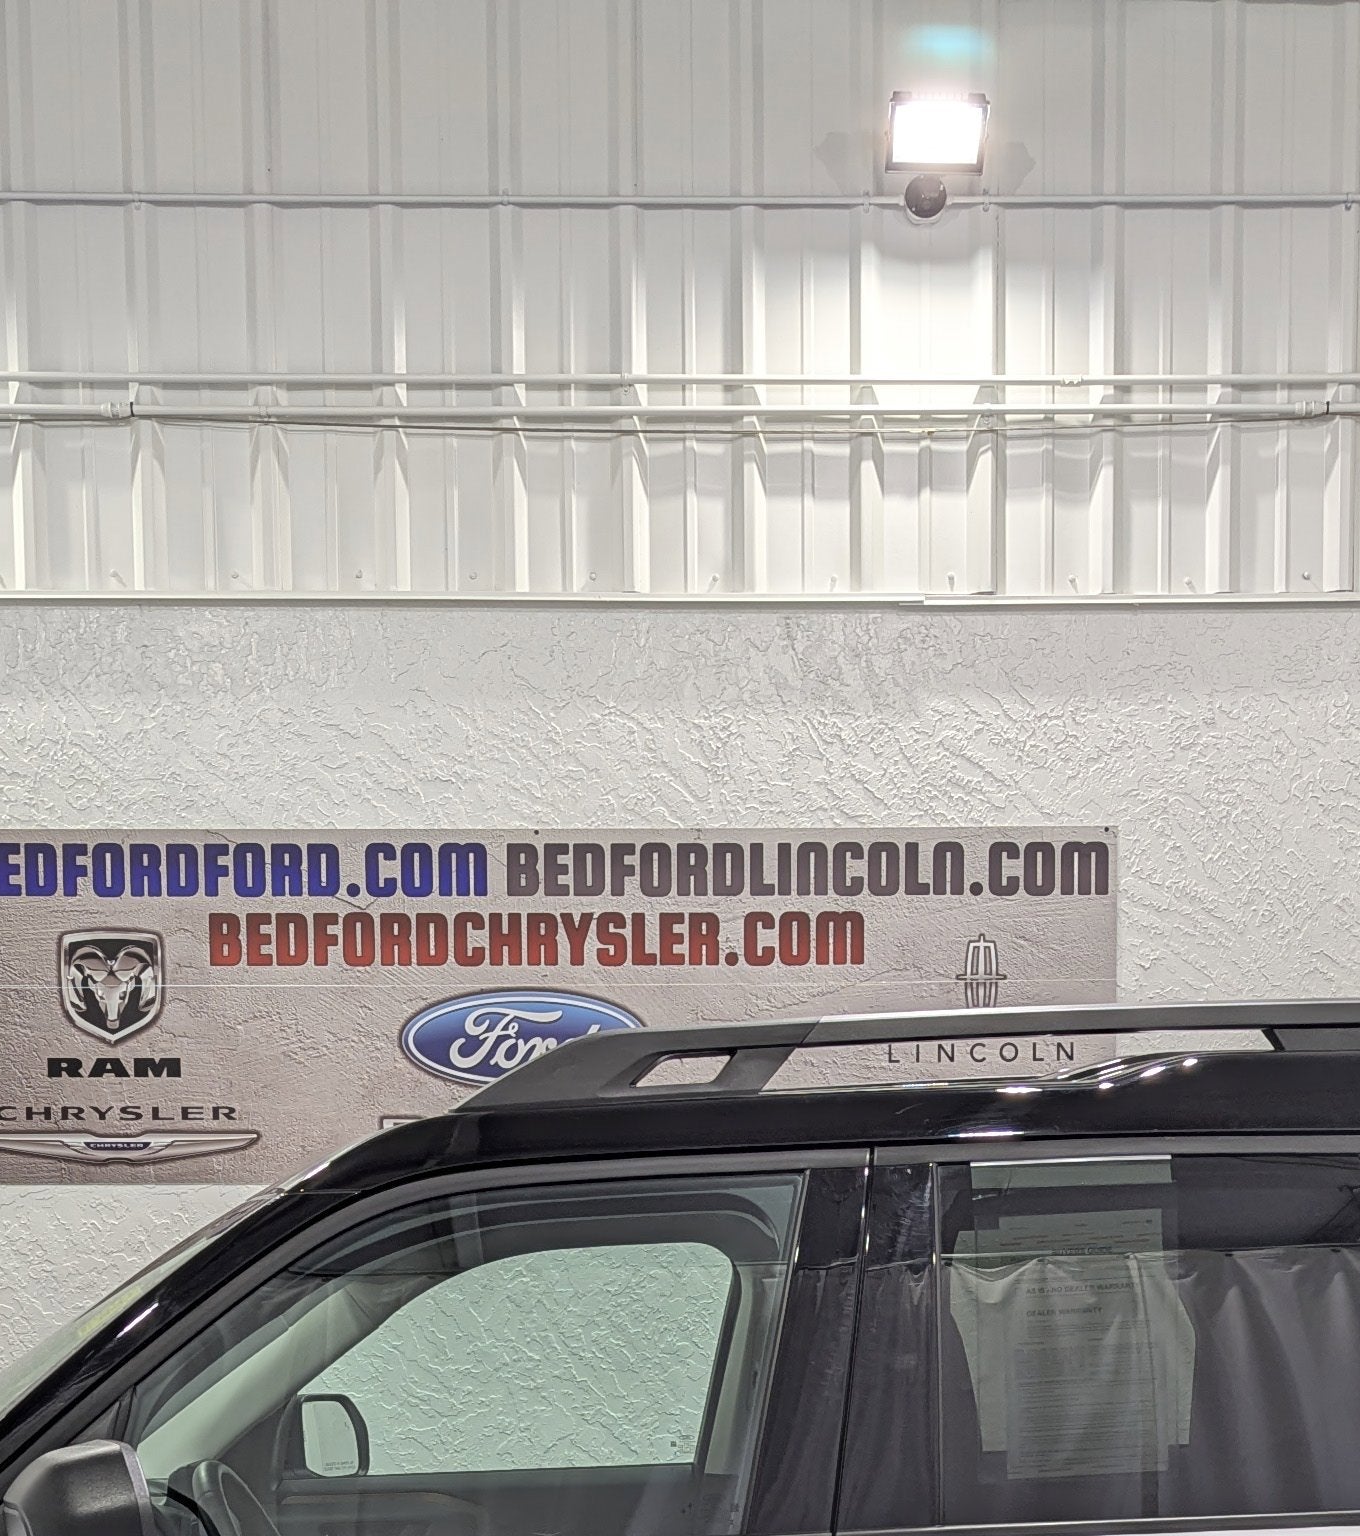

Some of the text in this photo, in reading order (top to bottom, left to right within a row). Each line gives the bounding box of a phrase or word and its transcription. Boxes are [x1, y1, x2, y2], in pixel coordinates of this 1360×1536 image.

[506, 841, 1109, 897] BEDFORDLINCOLN.COM
[208, 911, 866, 967] BEDFORDCHRYSLER.COM
[449, 1007, 601, 1069] For
[888, 1041, 1076, 1064] LINCOLN
[47, 1057, 182, 1079] RAM
[90, 1142, 145, 1150] CHRYSLER
